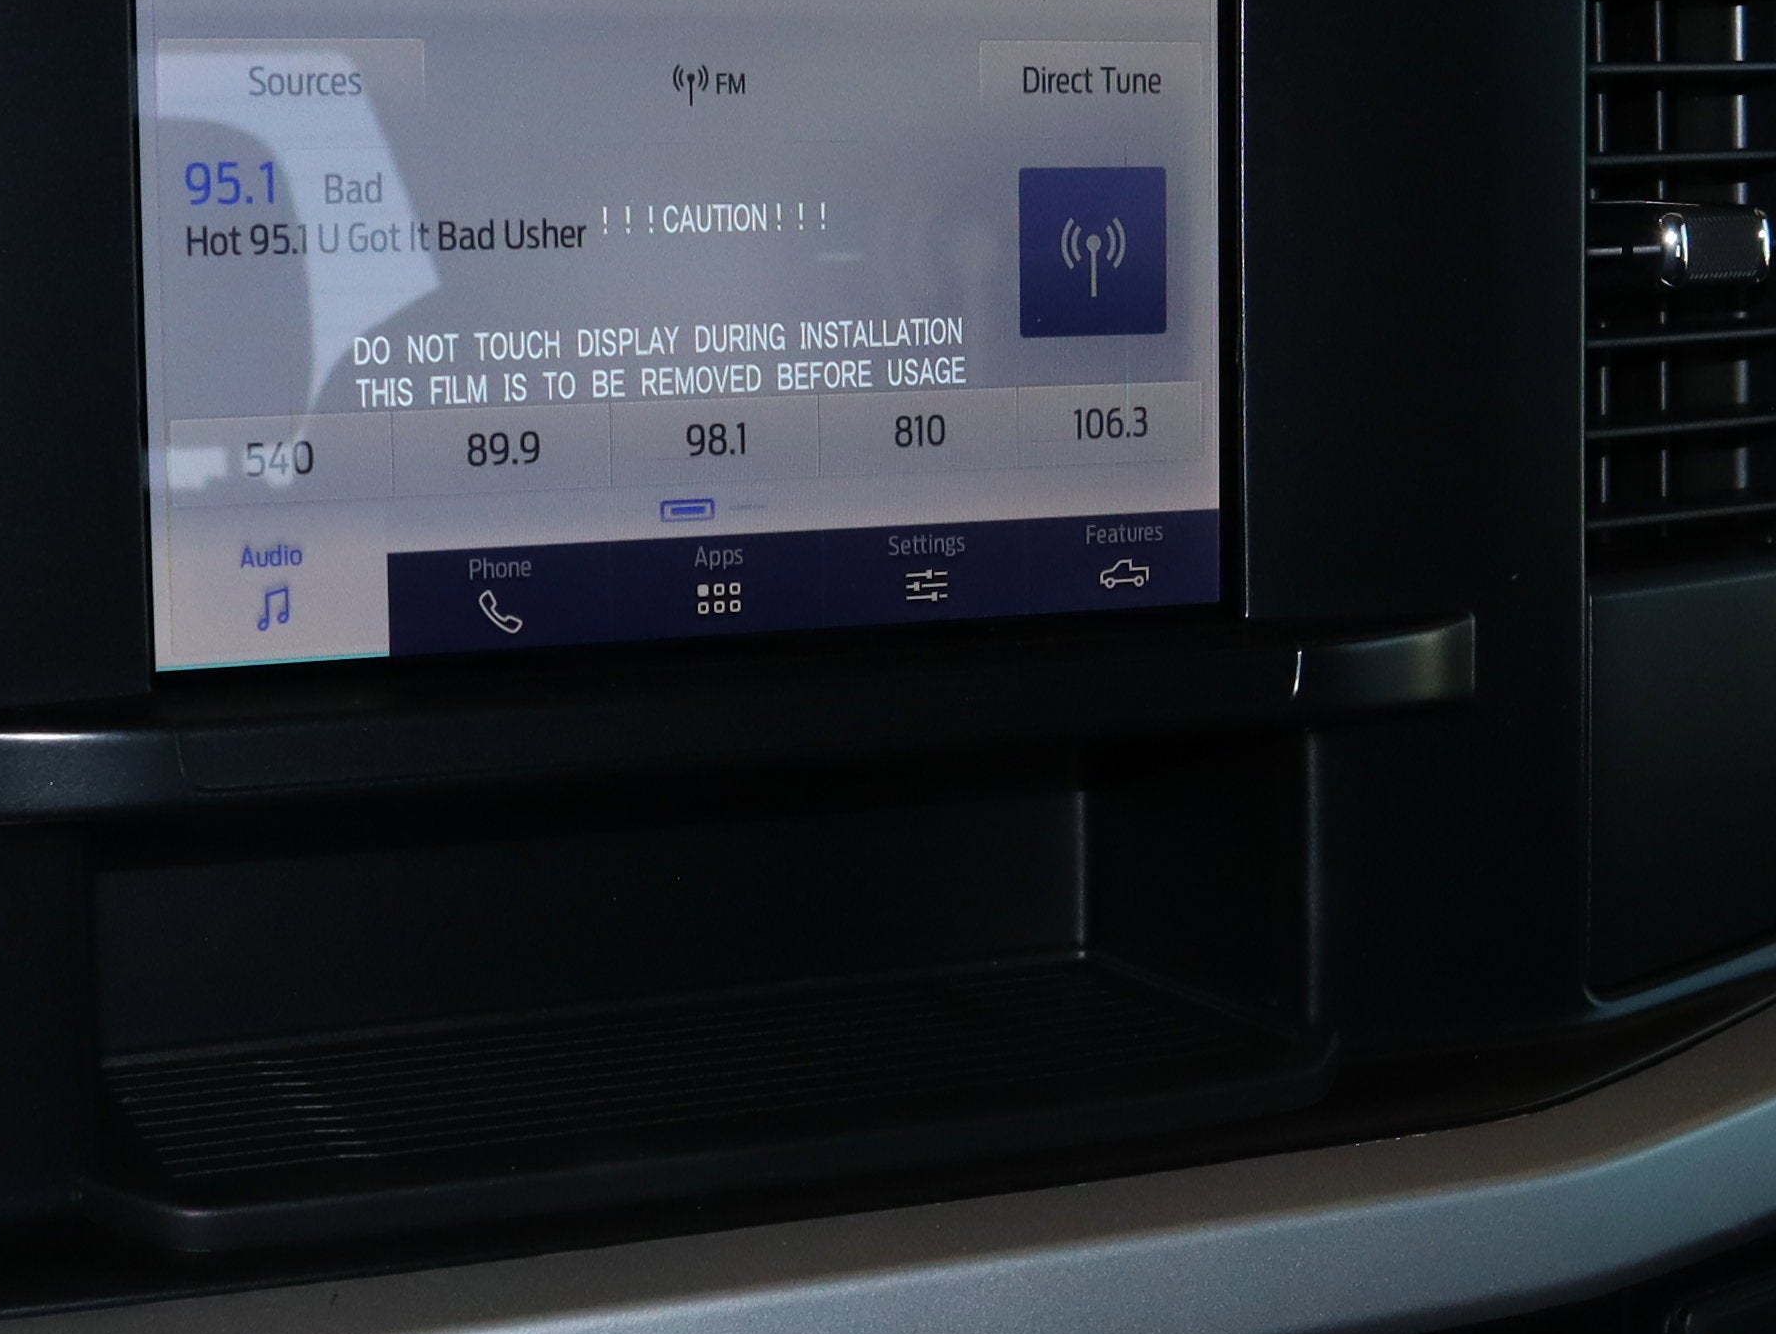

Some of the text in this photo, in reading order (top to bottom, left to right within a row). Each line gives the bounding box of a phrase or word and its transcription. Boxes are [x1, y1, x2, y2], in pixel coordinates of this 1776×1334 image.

[249, 66, 362, 97] Sources
[716, 73, 746, 95] FM
[1023, 66, 1162, 95] Direct Tune
[185, 161, 277, 205] 95.1
[325, 173, 382, 204] Bad
[186, 218, 587, 257] Hot 95.1 U Got It Bad Usher
[354, 317, 963, 366] DO NOT TOUCH DISPLAY DURING INSTALLATION
[356, 356, 967, 408] THIS FILM IS TO BE REMOVED BEFORE USAGE
[894, 415, 946, 448] 810
[1073, 406, 1149, 440] 106.3
[467, 431, 540, 467] 89.9
[686, 422, 747, 457] 98.1
[246, 440, 313, 477] 540
[888, 534, 965, 557] Settings
[1086, 523, 1163, 545] Features
[240, 544, 303, 568] Audio
[469, 557, 532, 580] Phone
[695, 545, 743, 570] Apps
